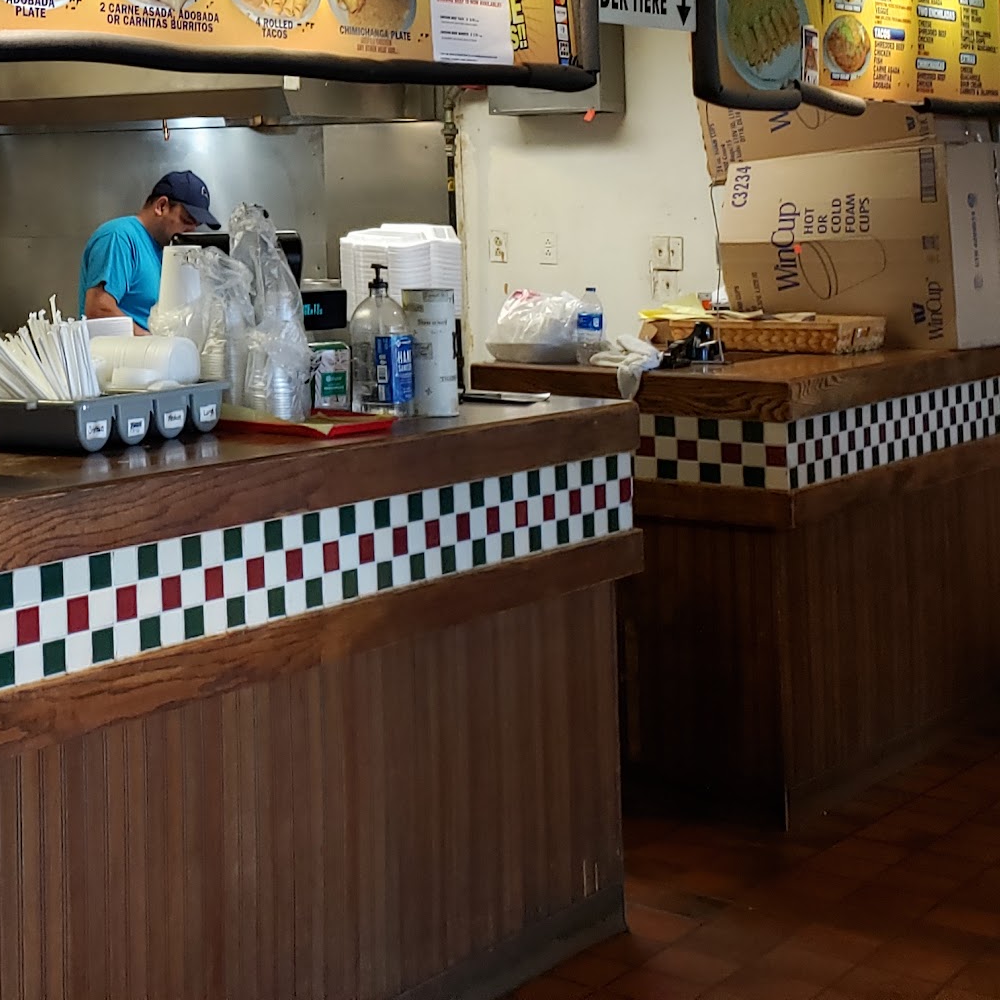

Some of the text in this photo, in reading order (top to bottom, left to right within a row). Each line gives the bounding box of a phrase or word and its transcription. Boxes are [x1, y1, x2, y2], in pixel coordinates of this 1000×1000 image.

[14, 5, 47, 19] PLATE
[100, 2, 106, 13] 2
[108, 3, 140, 16] CARNE
[178, 9, 220, 24] ADOBADA
[107, 14, 213, 33] OR CARNITAS BURRITOS
[261, 28, 288, 40] TACOS
[263, 18, 294, 31] ROLLED
[339, 25, 411, 41] CHIMICHANGA PLATE
[874, 27, 891, 40] TACOS
[731, 165, 752, 208] C3234
[803, 207, 814, 235] HOT
[817, 214, 828, 234] OR
[831, 198, 842, 234] COLD
[844, 193, 856, 233] FOAM
[859, 197, 870, 233] CUPS
[771, 201, 800, 292] WinCup
[926, 281, 944, 340] WinCup
